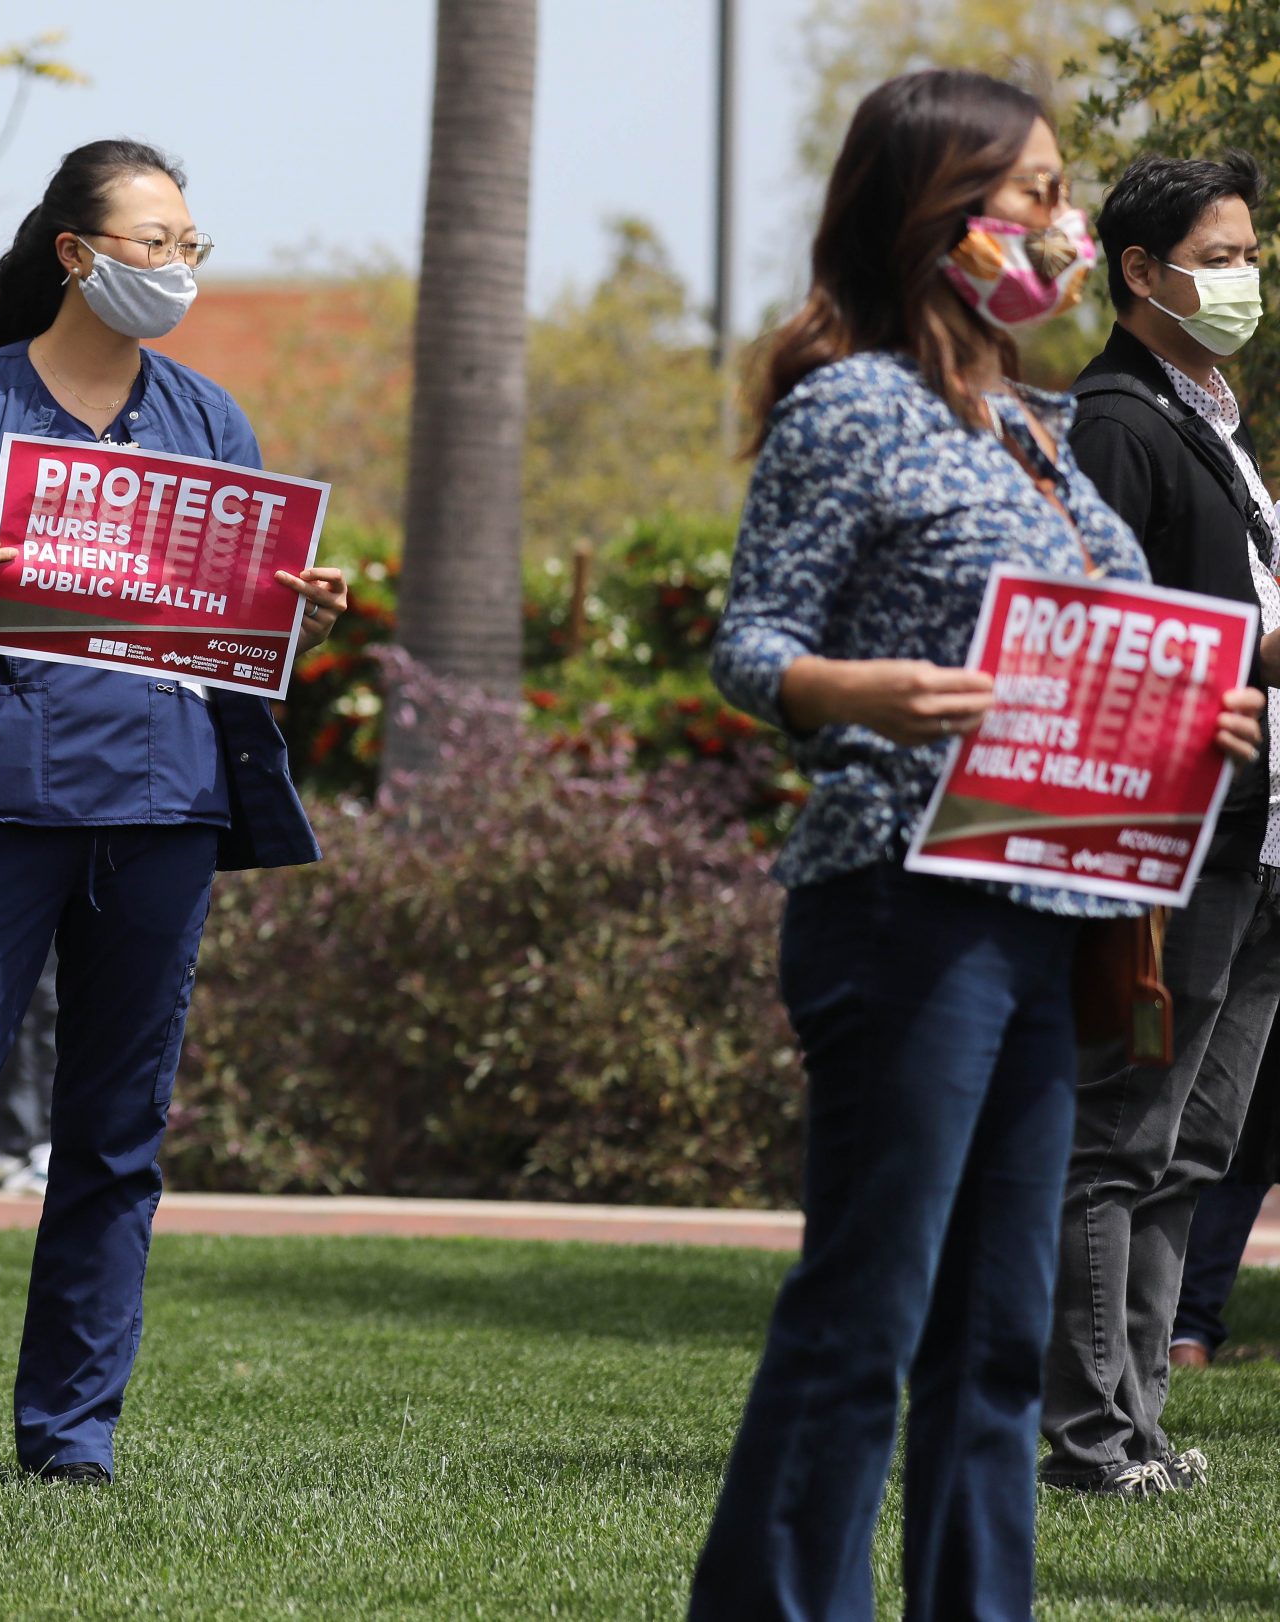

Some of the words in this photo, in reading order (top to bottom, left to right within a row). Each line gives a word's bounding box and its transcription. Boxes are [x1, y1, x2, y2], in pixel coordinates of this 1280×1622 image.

[35, 458, 286, 532] PROTECT
[26, 514, 132, 545] NURSES
[23, 540, 150, 576] PATIENTS
[20, 567, 115, 598] PUBLIC
[120, 580, 228, 615] HEALTH
[127, 653, 155, 662] Association
[207, 639, 278, 661] #COVID19
[1001, 594, 1222, 684] PROTECT
[993, 672, 1070, 710] NURSES
[978, 710, 1080, 751] PATIENTS
[964, 744, 1041, 782] PUBLIC
[1040, 752, 1152, 801] HEALTH
